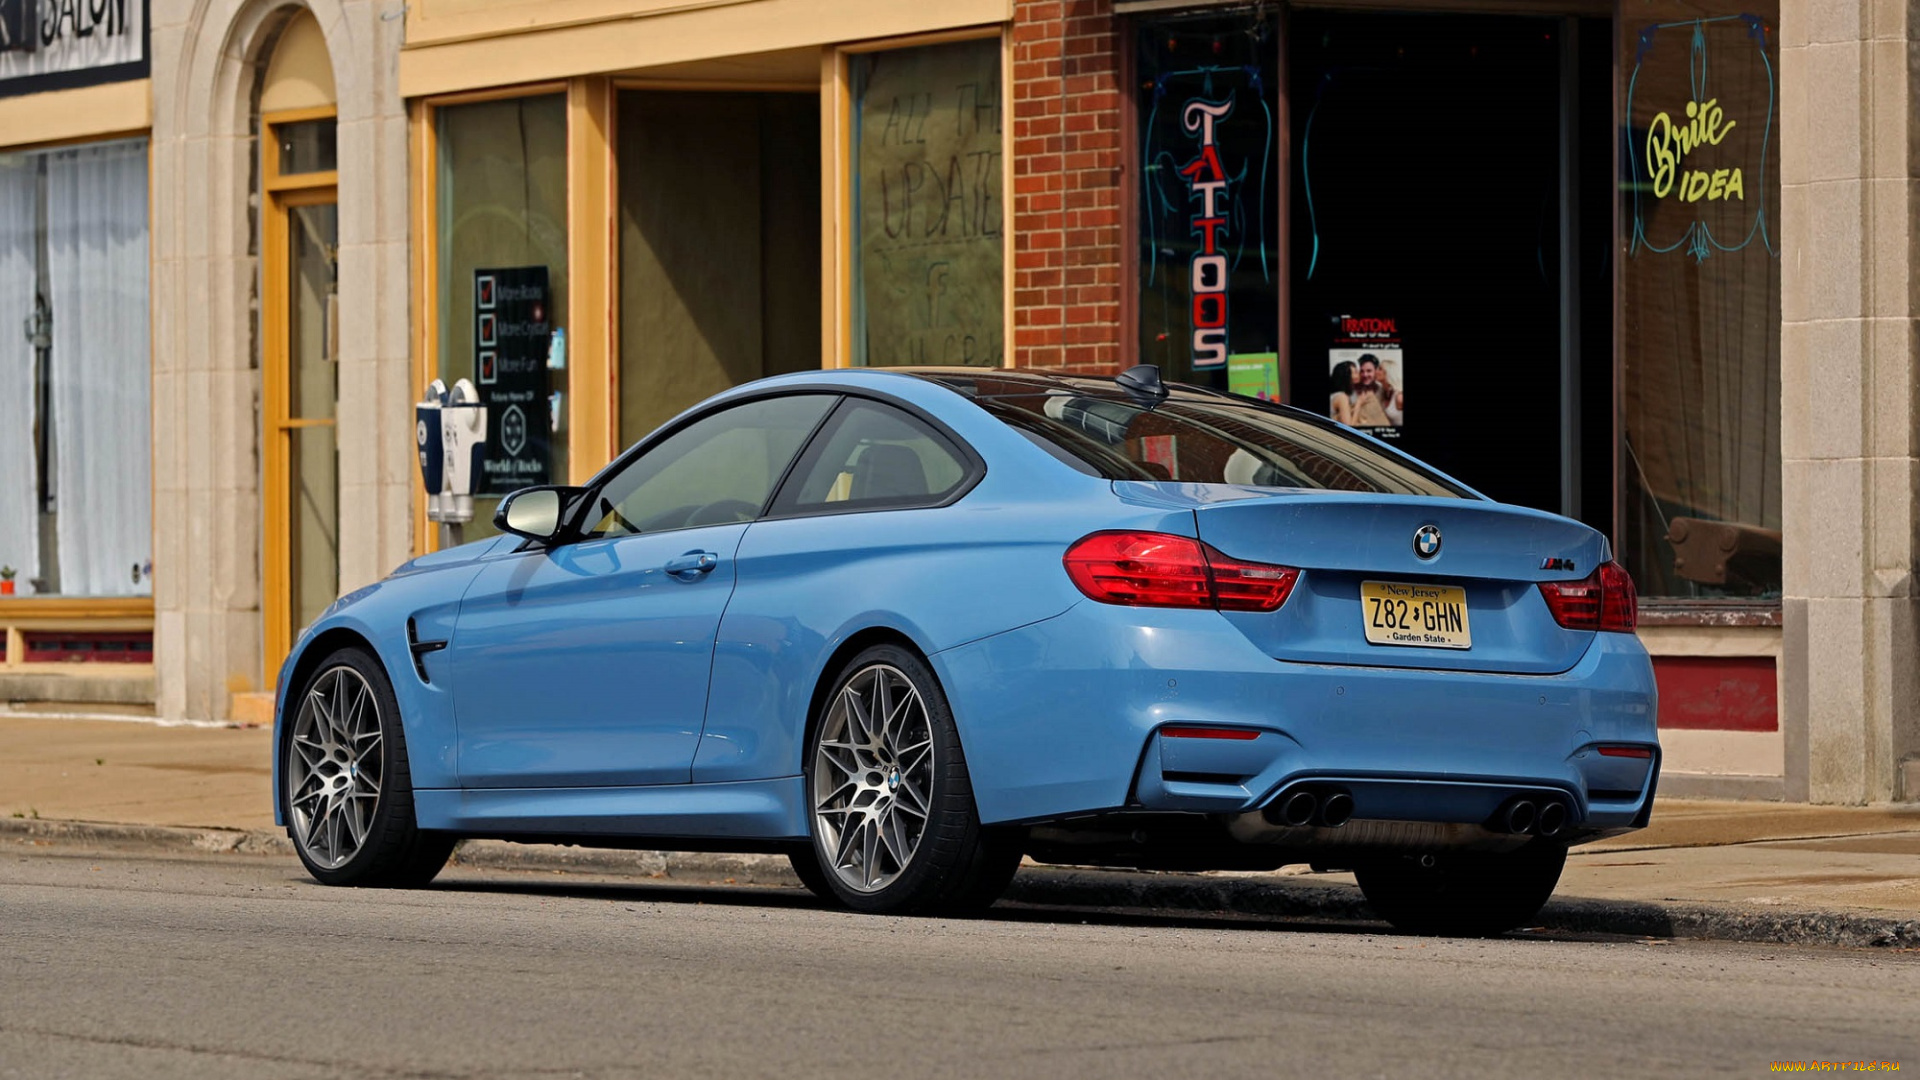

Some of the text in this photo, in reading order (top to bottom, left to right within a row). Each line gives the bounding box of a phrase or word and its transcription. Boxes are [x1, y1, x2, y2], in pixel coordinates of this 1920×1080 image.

[41, 0, 125, 46] SALON
[881, 91, 931, 146] ALL
[1646, 98, 1736, 198] Brite
[1679, 168, 1744, 202] IDEA
[1181, 99, 1232, 366] TATTOOS
[1387, 584, 1440, 599] New Jersey
[1369, 597, 1463, 633] Z82 GHN
[1392, 631, 1446, 643] Garden State
